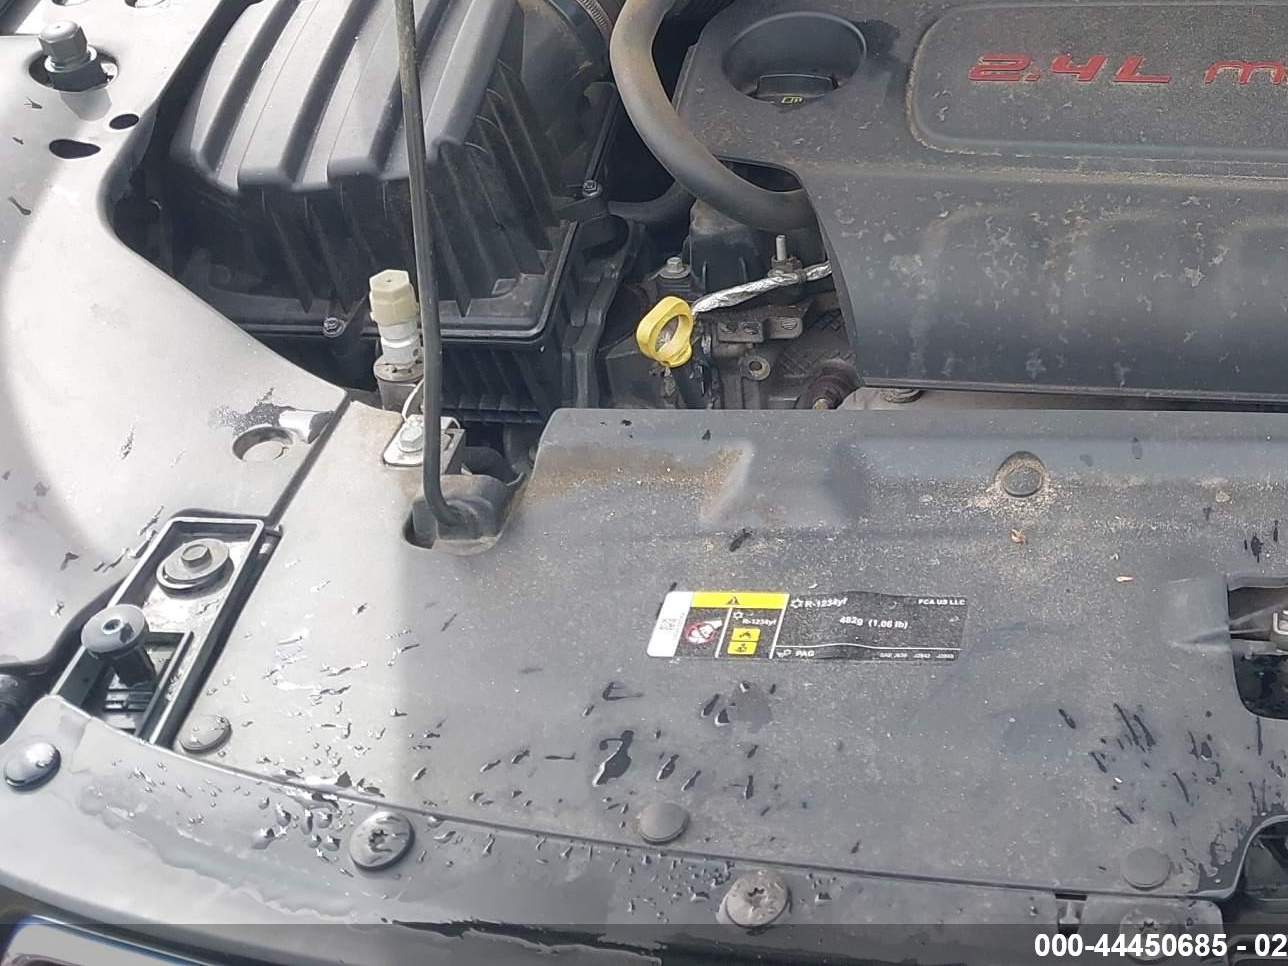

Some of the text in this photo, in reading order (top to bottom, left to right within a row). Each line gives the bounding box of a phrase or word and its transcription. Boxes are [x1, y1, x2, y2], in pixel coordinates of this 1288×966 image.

[804, 597, 848, 608] R-1234yf
[918, 598, 935, 606] FCA
[949, 598, 966, 606] LLC
[839, 616, 863, 627] 482g
